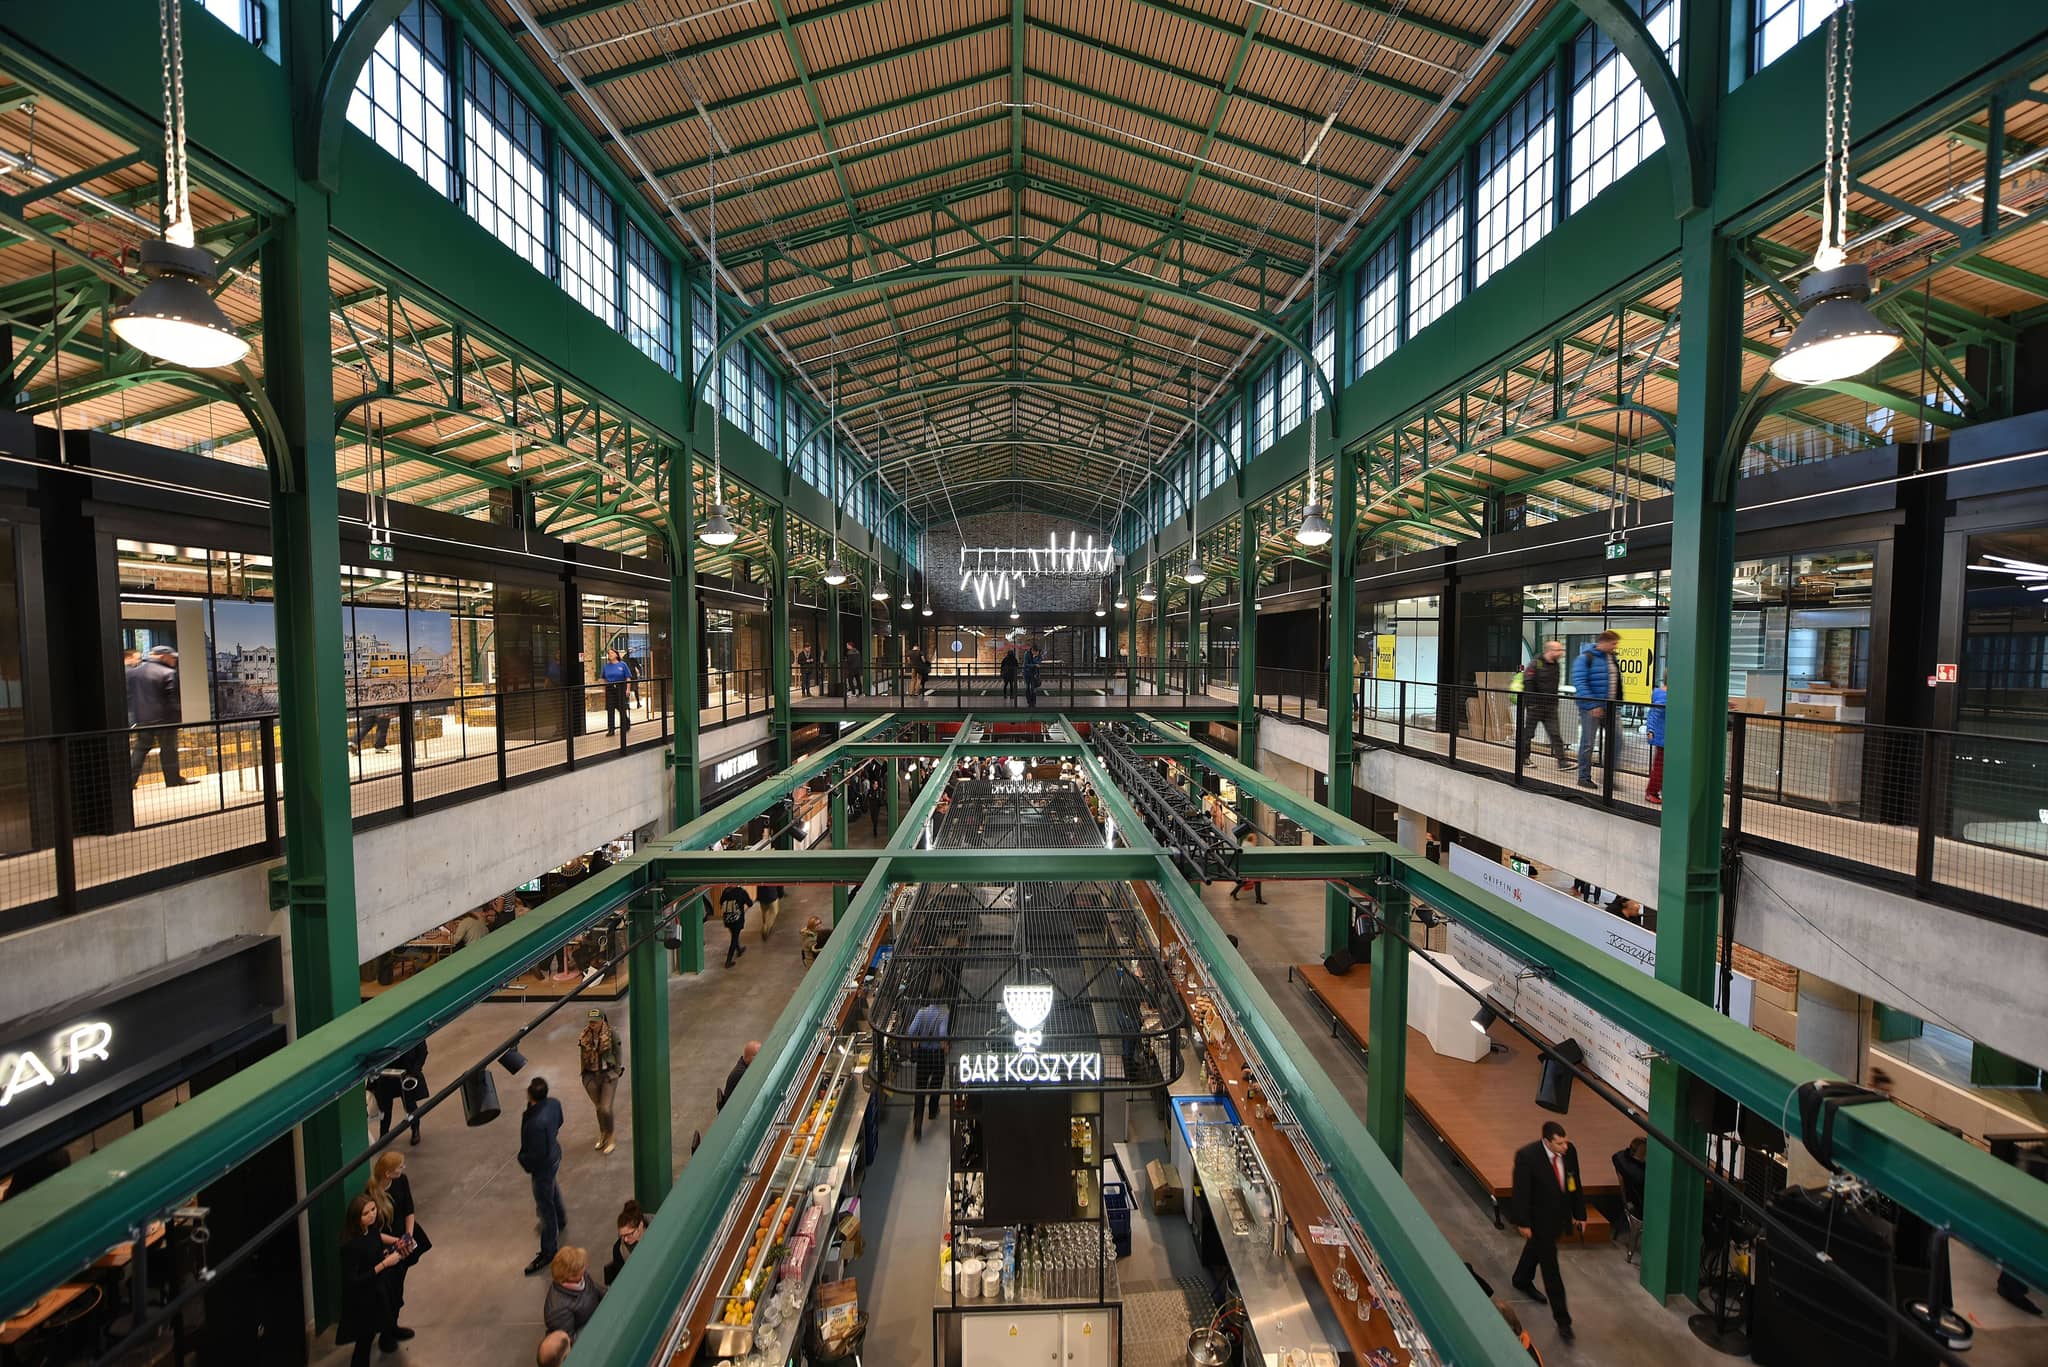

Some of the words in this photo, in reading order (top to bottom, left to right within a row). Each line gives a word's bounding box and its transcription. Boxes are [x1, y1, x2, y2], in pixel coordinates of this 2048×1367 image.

[1617, 648, 1643, 657] OMFORT
[1618, 659, 1642, 673] OOD
[1608, 934, 1656, 965] Koszyk
[960, 1054, 999, 1082] BAR
[1004, 1053, 1100, 1082] KOSZYKI
